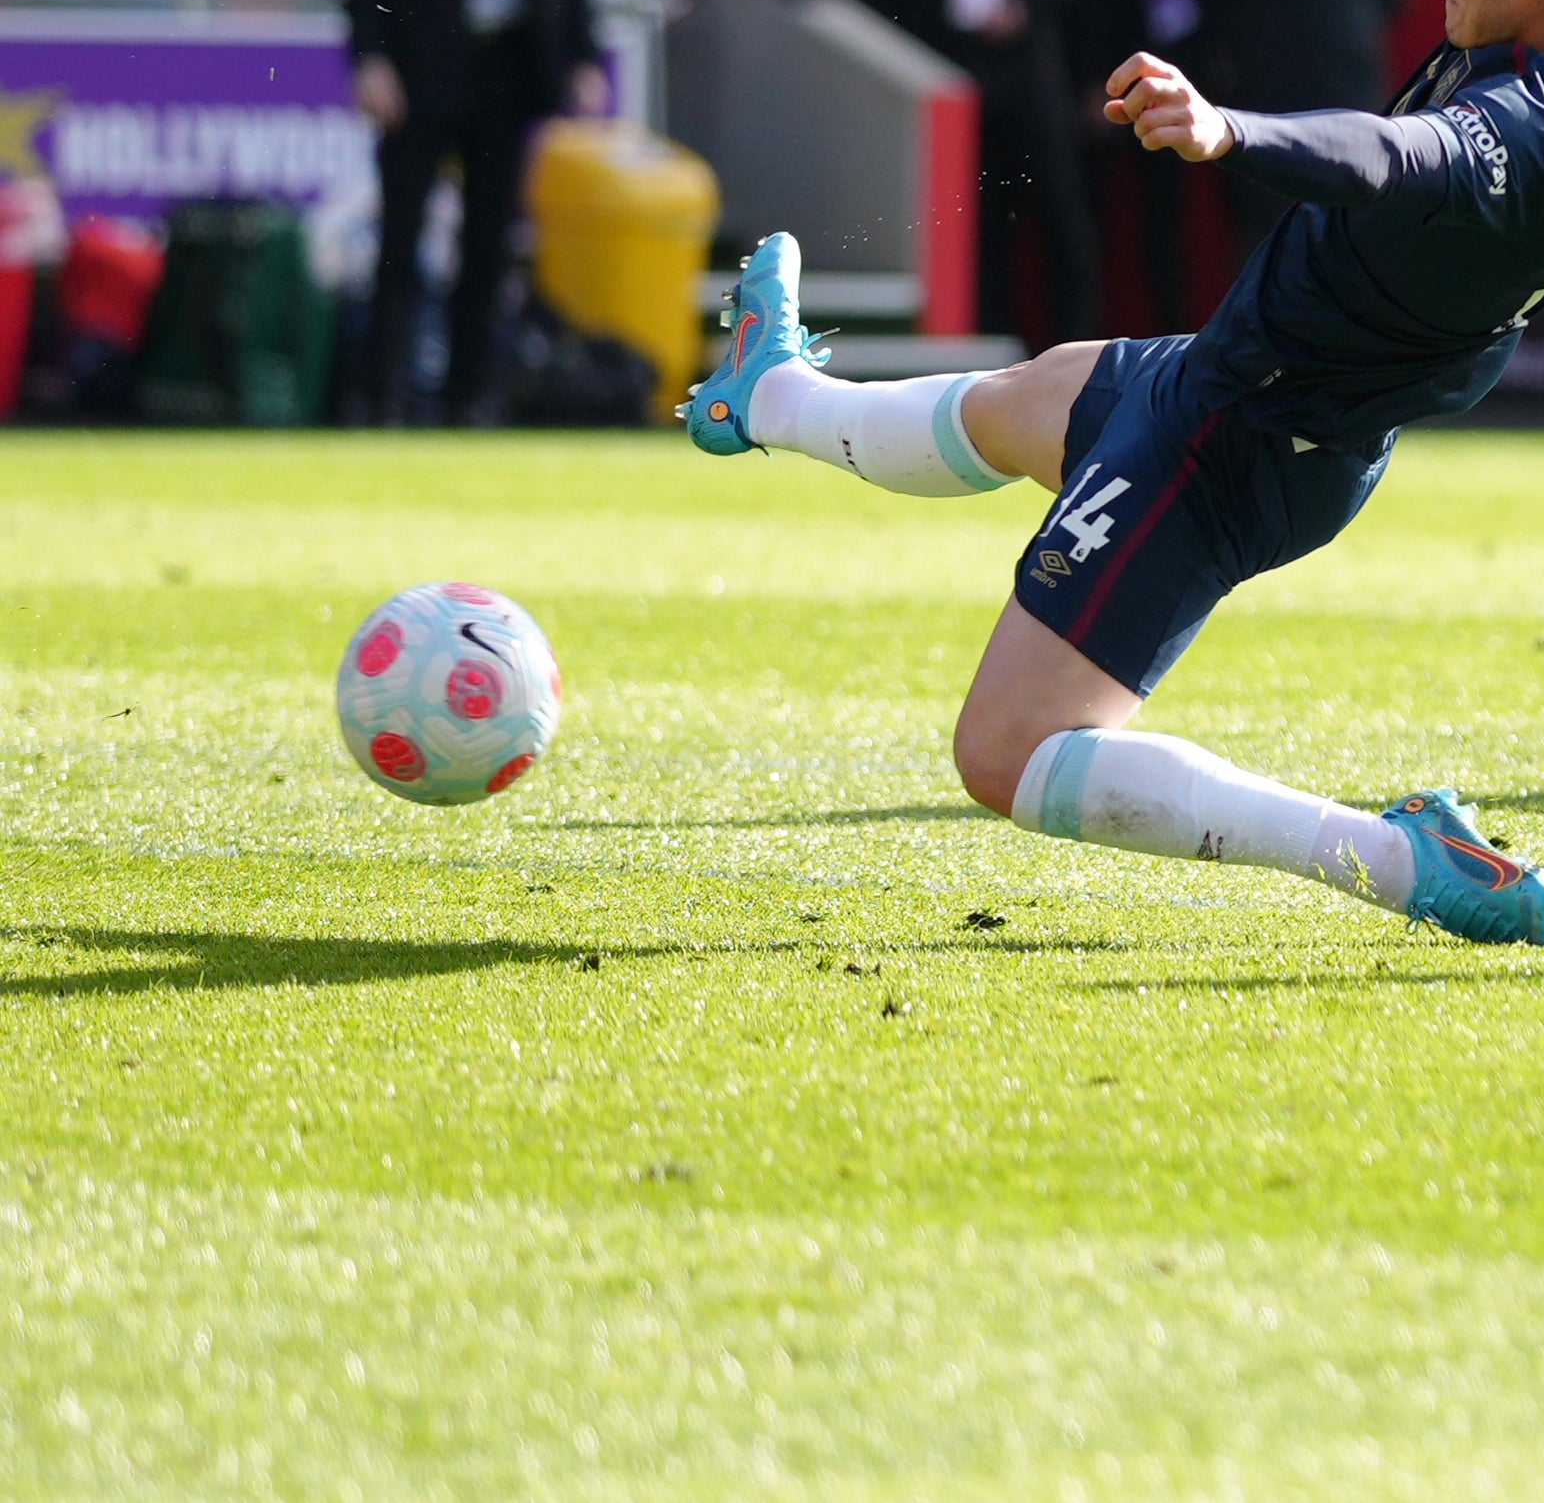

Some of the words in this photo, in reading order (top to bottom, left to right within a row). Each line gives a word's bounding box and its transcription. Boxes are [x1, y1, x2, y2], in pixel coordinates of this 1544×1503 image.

[1442, 105, 1509, 195] AstroPay
[1039, 463, 1133, 564] 14
[1028, 567, 1058, 590] umbro
